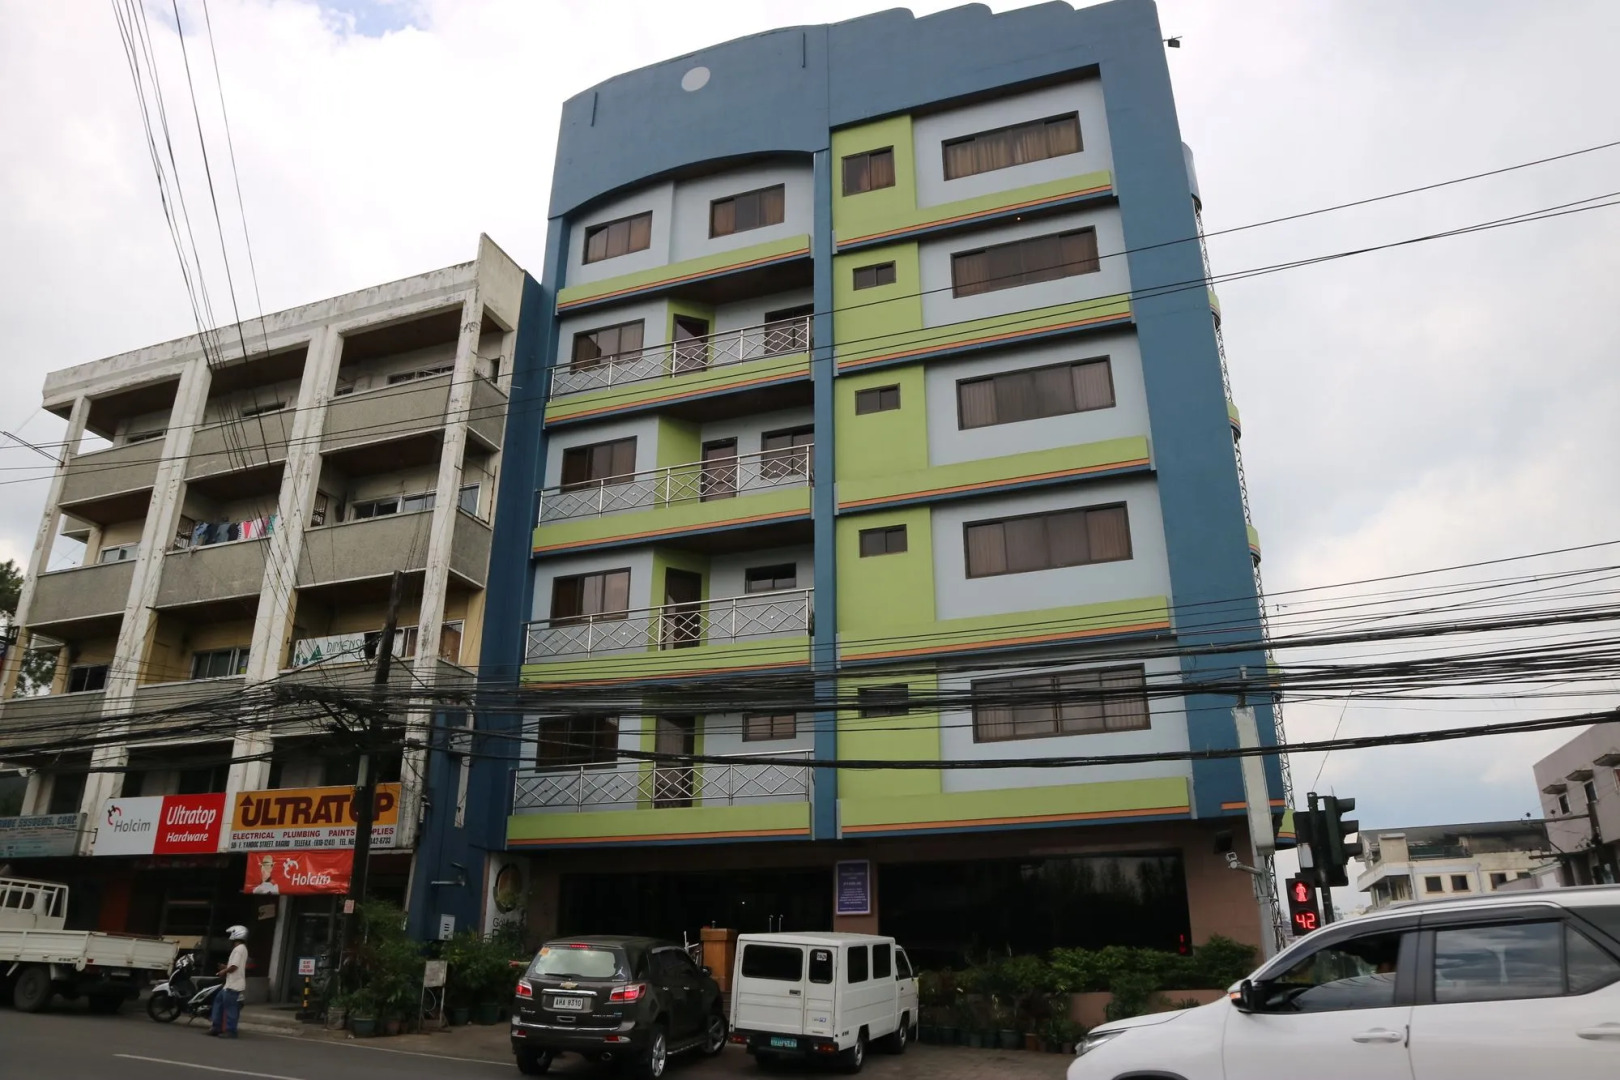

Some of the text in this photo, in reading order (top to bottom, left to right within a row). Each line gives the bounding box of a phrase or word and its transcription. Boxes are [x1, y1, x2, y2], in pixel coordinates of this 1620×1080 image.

[326, 638, 365, 654] DIMENSI
[166, 804, 217, 830] Ultratop
[114, 818, 151, 832] Holcim
[165, 830, 209, 842] Hardware
[232, 831, 275, 840] ELECTRICAL
[282, 830, 321, 838] PLUMBING
[328, 829, 355, 837] PAINTS
[291, 872, 331, 886] Holcim
[1295, 912, 1316, 929] 42
